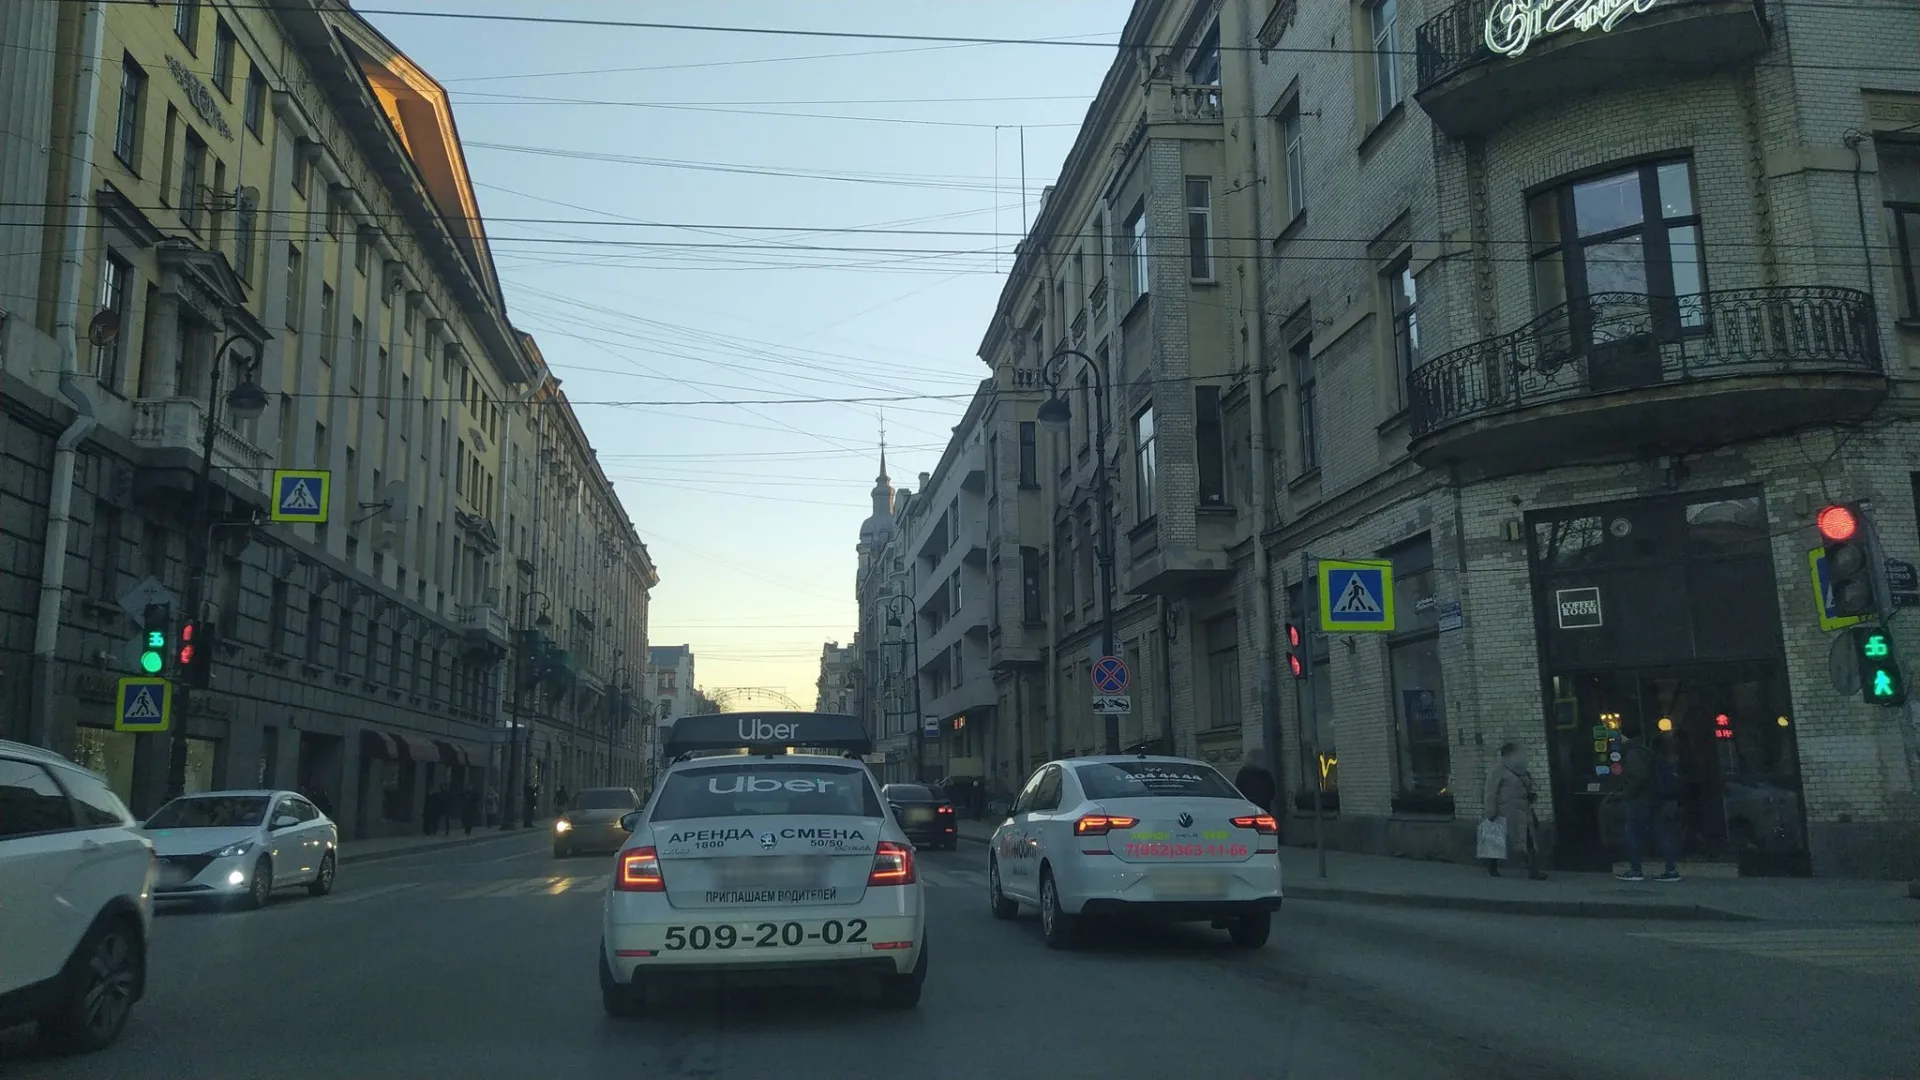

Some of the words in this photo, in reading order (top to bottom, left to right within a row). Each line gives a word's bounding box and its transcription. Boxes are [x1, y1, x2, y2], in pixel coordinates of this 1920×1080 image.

[1561, 600, 1597, 609] COFFEE
[1562, 607, 1597, 616] ROOM
[738, 719, 799, 740] Uber
[708, 776, 835, 794] Uber
[669, 829, 753, 843] АРЕНДА
[780, 829, 864, 841] СМЕНА
[695, 840, 724, 849] 1800
[810, 839, 843, 848] 50/50
[705, 889, 775, 904] ПРИГЛАШАЕМ
[777, 886, 836, 903] ВОДИТЕЛЕЙ
[664, 919, 868, 951] 509-20-02
